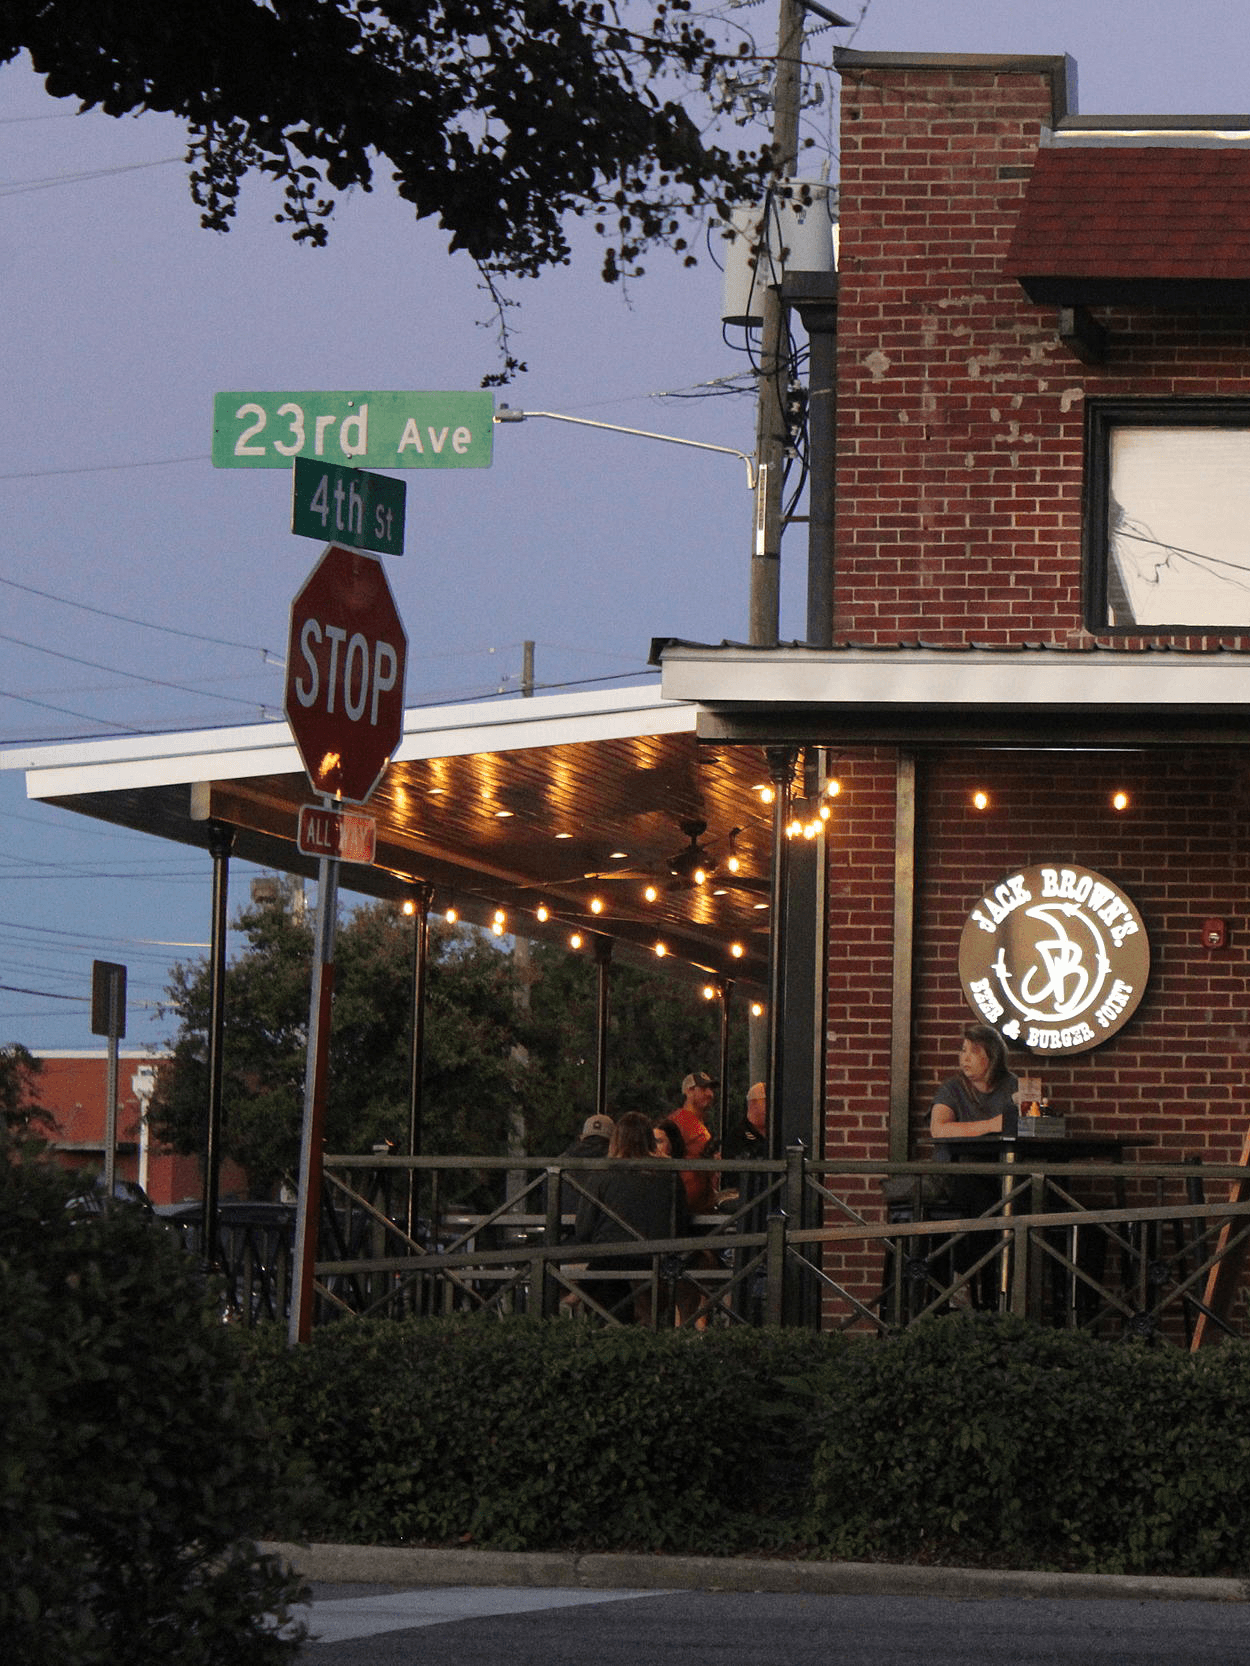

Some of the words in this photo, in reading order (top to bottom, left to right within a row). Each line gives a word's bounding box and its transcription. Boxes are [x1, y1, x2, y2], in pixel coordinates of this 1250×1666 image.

[233, 402, 369, 457] 23rd
[397, 417, 473, 455] Ave
[309, 474, 364, 535] 4th
[374, 503, 394, 542] St
[295, 618, 398, 727] STOP
[306, 816, 332, 848] ALL
[971, 874, 1032, 933] JACK
[969, 977, 1005, 1024] BEER
[1002, 1018, 1021, 1041] &
[1025, 1021, 1096, 1049] BURGER
[1094, 978, 1133, 1028] JOINT
